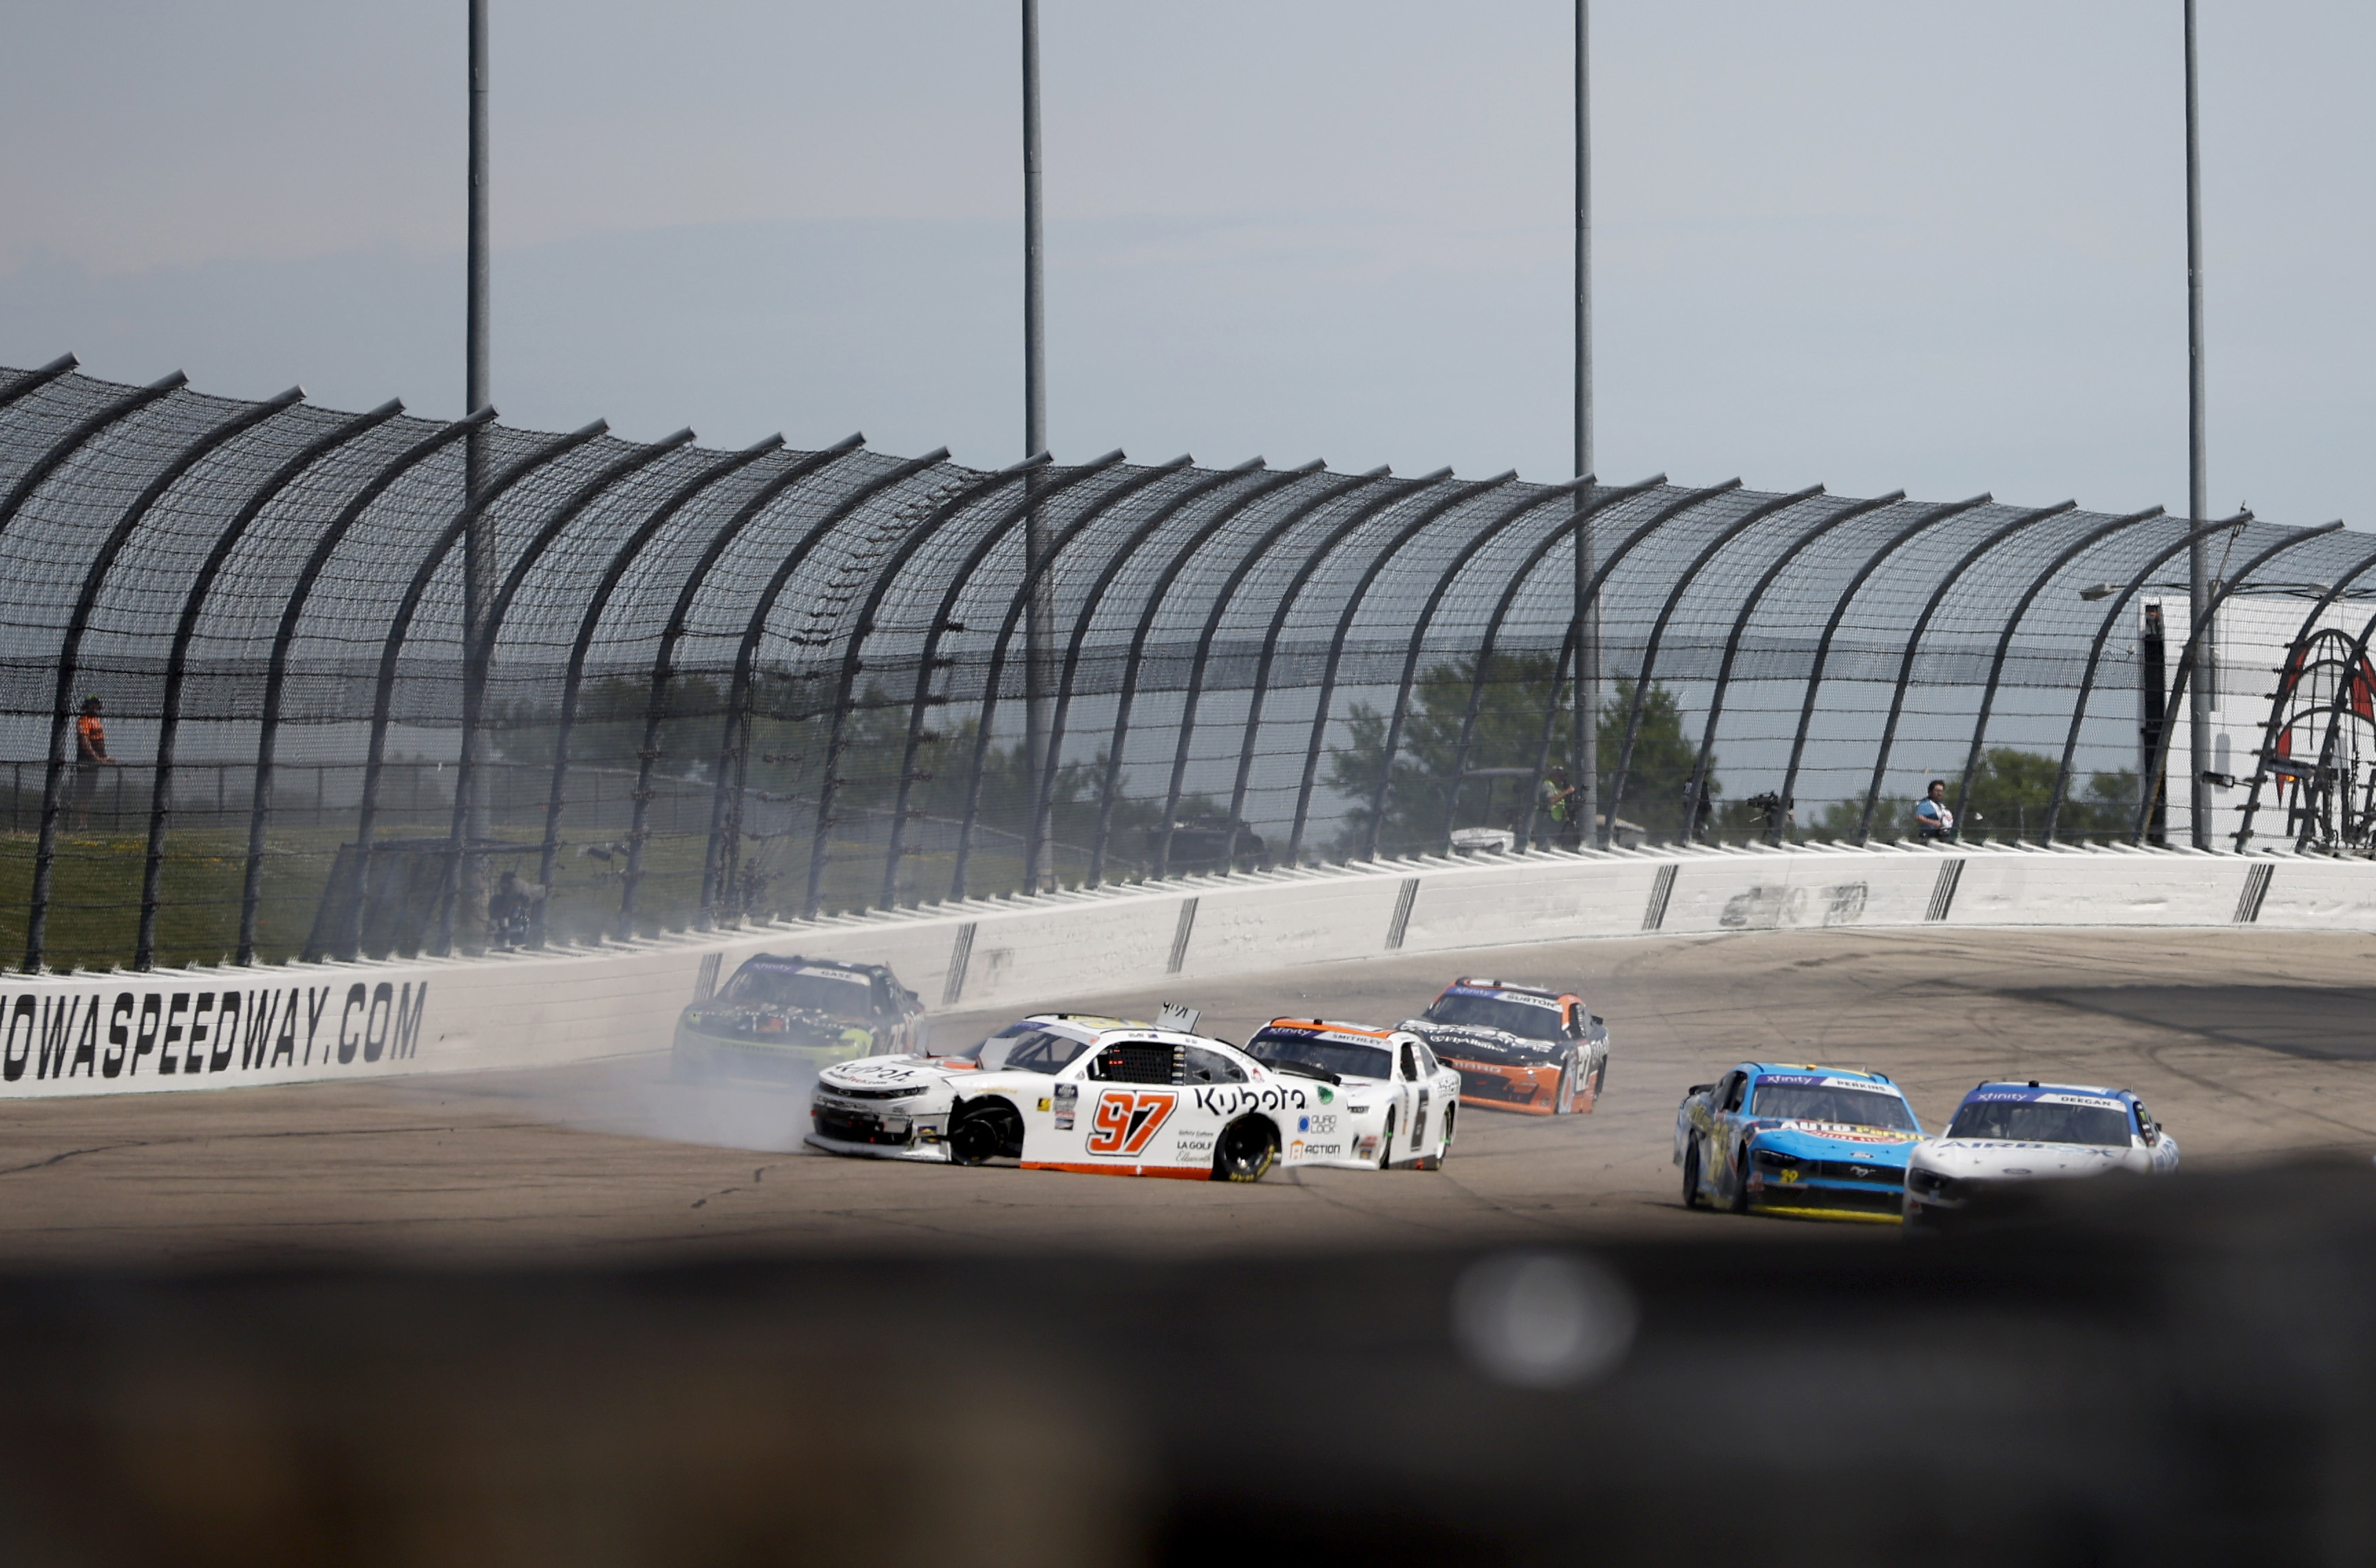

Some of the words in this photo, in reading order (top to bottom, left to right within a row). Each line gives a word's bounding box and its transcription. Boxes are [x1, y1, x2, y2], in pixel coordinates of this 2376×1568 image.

[1507, 993, 1556, 1008] BURTON
[1269, 1026, 1312, 1037] xfinity
[1333, 1032, 1383, 1046] SMITHLEY
[1767, 1075, 1812, 1085] xfinity
[1837, 1079, 1886, 1092] PERKINS
[1194, 1085, 1306, 1116] Kubota
[1977, 1092, 2028, 1101] xfinity
[2061, 1096, 2111, 1106] DEEGAN
[1086, 1090, 1178, 1156] 97
[1311, 1114, 1337, 1124] QUAD
[1310, 1123, 1335, 1134] LOCK
[1189, 1141, 1213, 1150] GOLF
[1305, 1144, 1341, 1154] ACTION
[1938, 1141, 2115, 1158] AIRBOX
